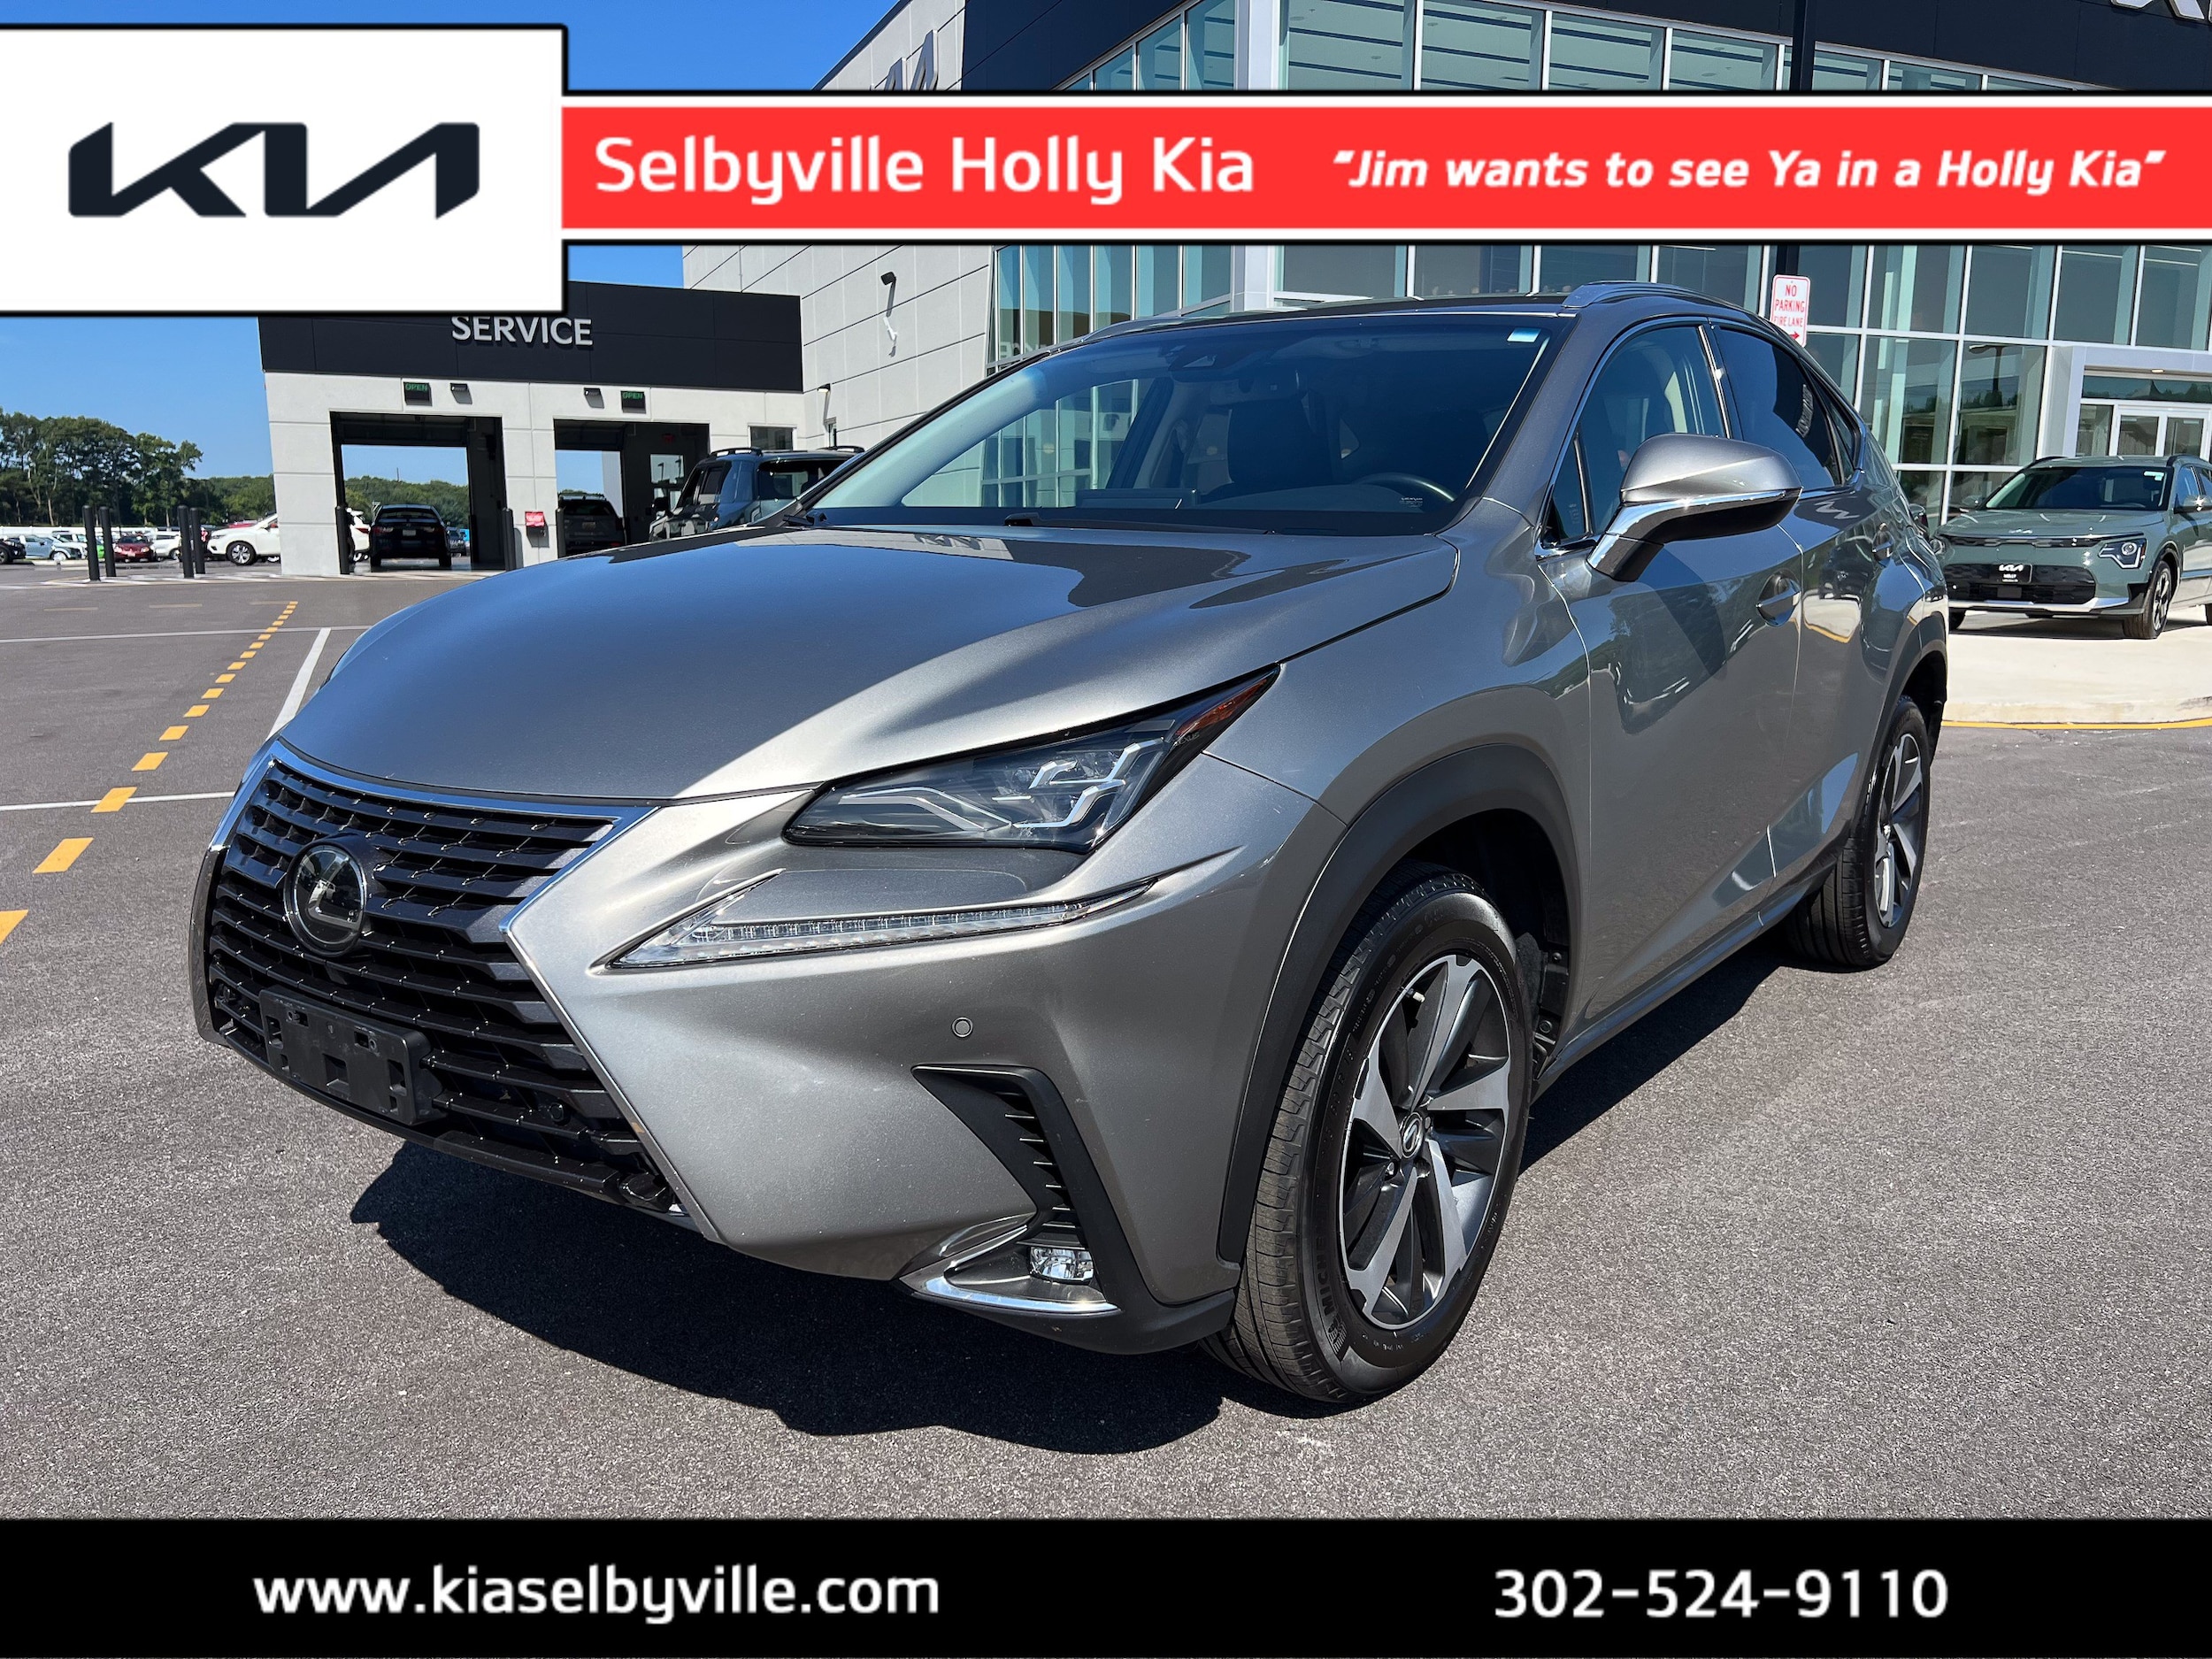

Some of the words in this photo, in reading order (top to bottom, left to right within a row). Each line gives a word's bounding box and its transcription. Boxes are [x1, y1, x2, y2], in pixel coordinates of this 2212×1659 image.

[1786, 285, 1797, 296] NO
[1775, 300, 1804, 312] PARKING
[1788, 318, 1803, 327] LANE
[452, 316, 593, 345] SERVICE
[405, 382, 428, 392] OPEN
